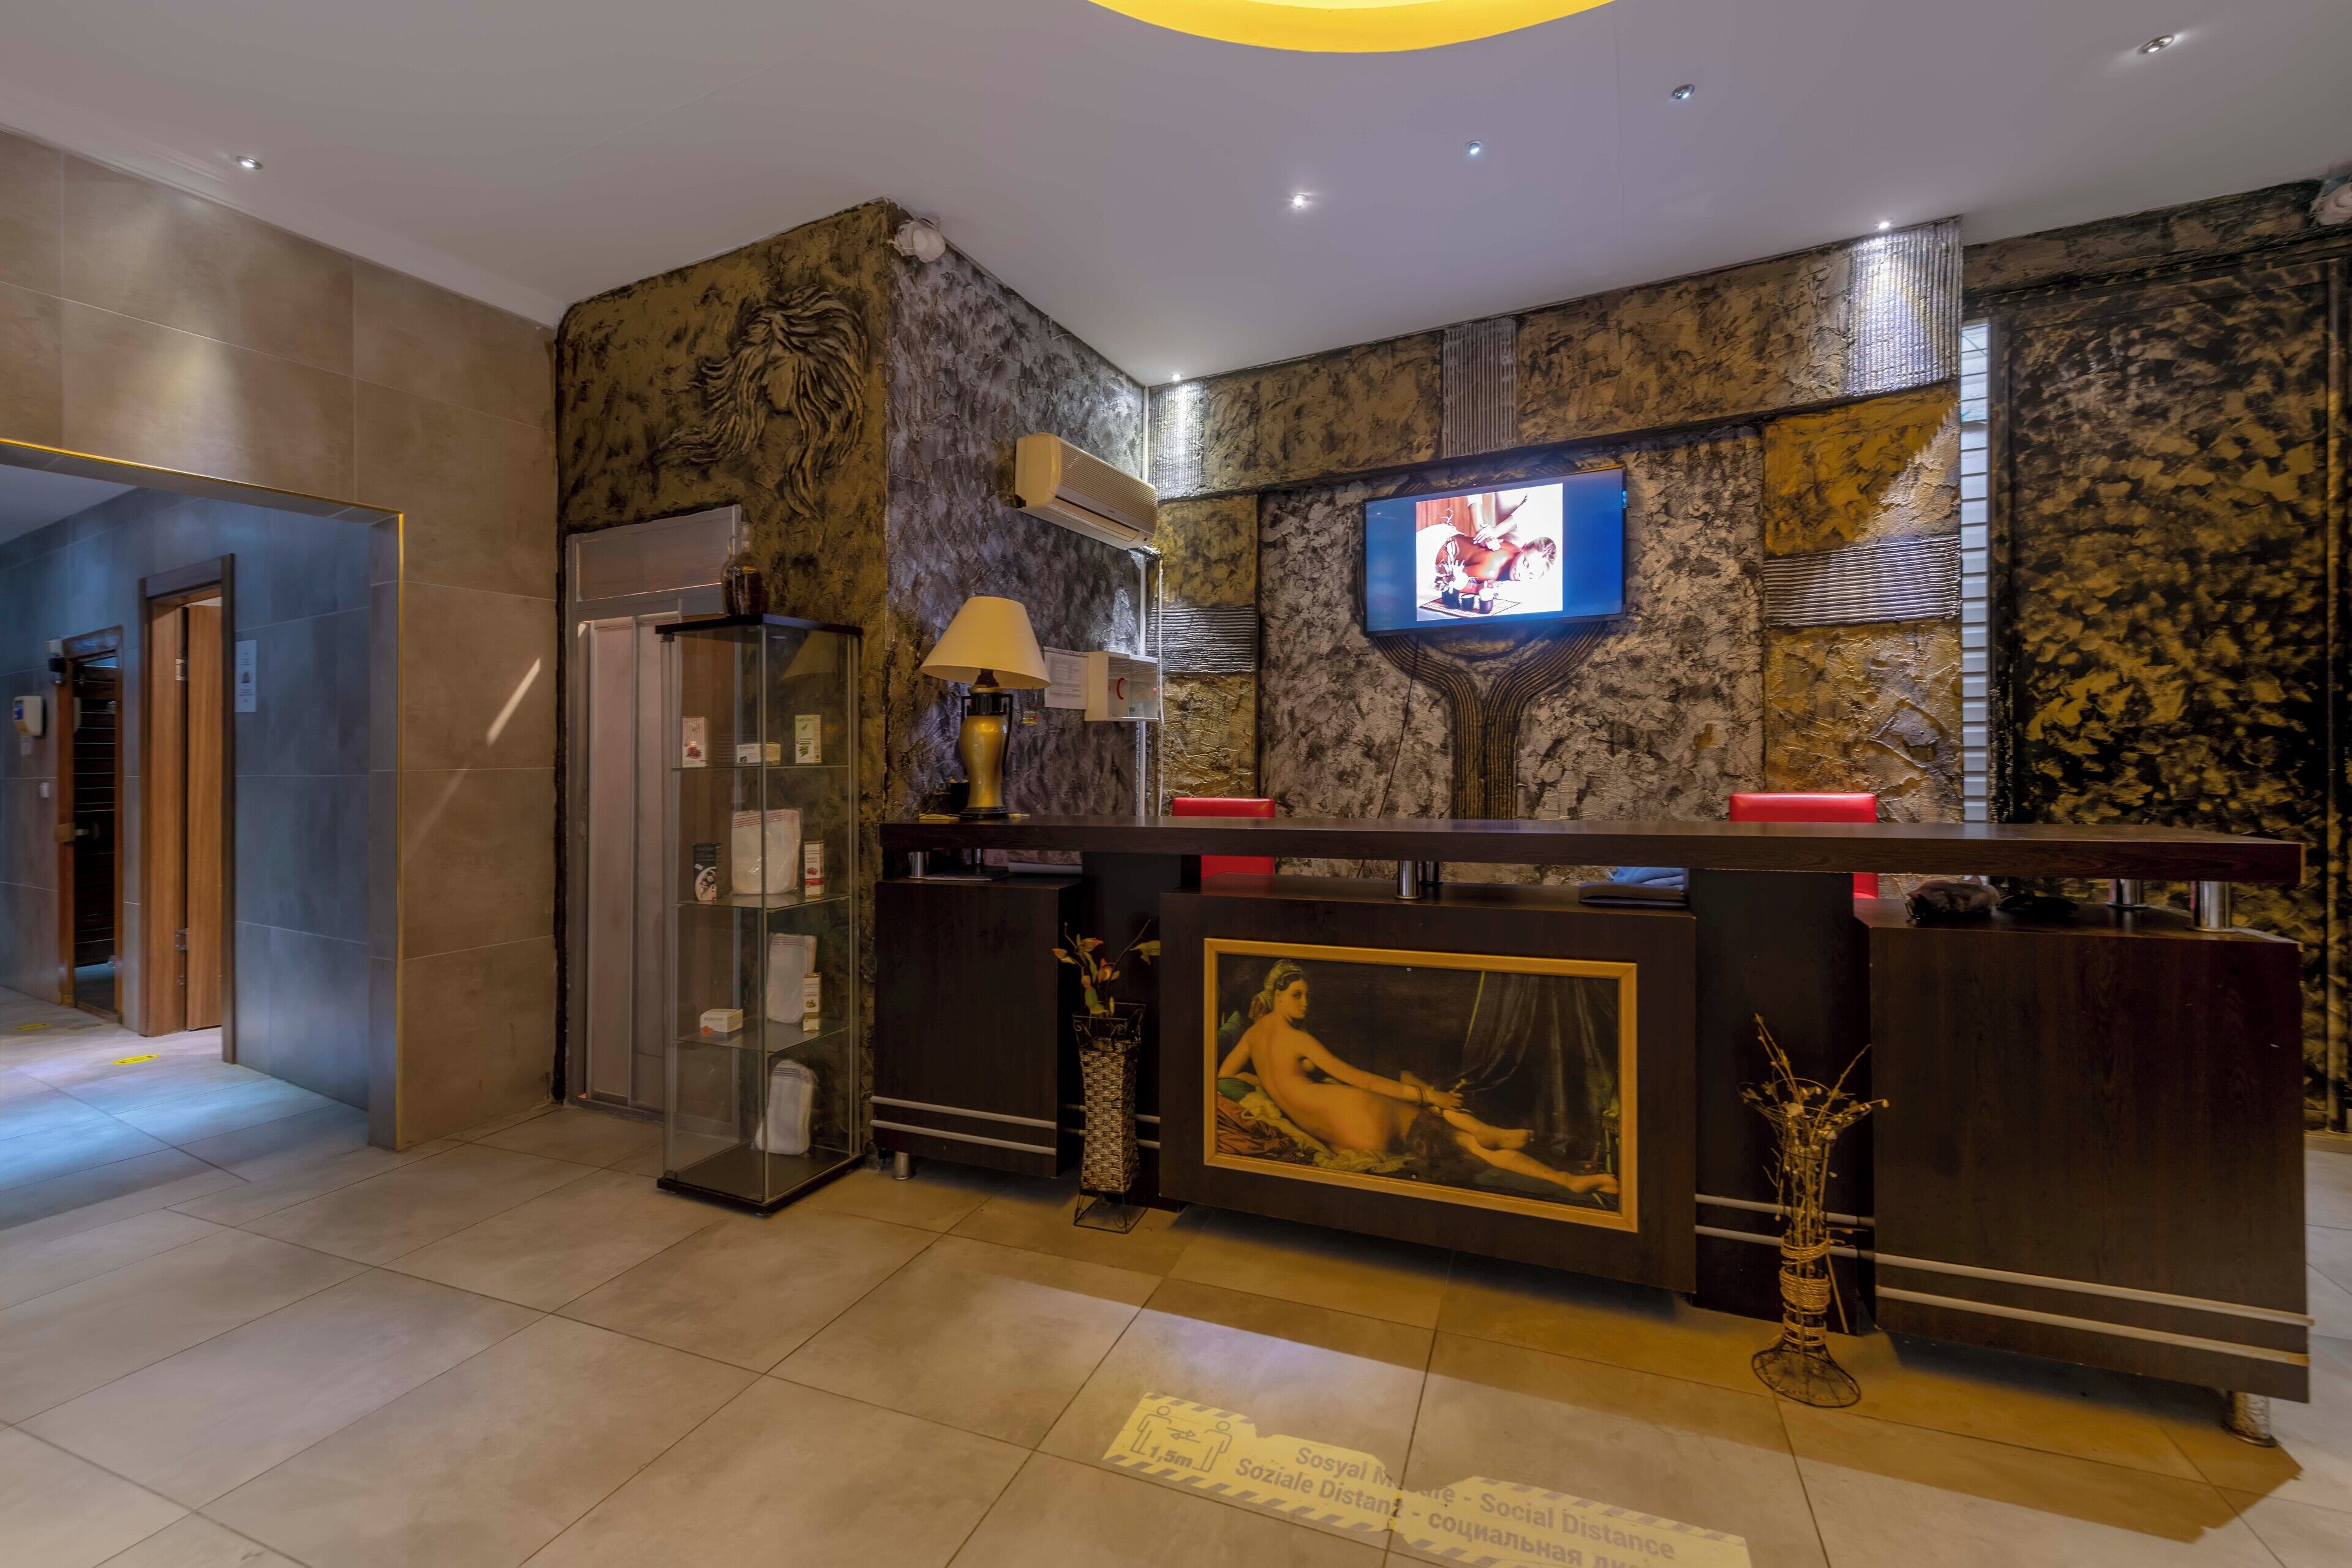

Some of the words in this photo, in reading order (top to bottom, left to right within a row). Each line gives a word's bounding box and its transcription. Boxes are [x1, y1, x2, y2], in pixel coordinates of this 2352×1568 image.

[1150, 1446, 1194, 1468] 1,5m
[1295, 1447, 1368, 1480] Sosyal
[1480, 1493, 1554, 1529] Social
[1561, 1512, 1675, 1560] Distance
[1235, 1458, 1313, 1494] Soziale
[1319, 1478, 1404, 1518] Distanz
[1428, 1512, 1582, 1567] социальная
